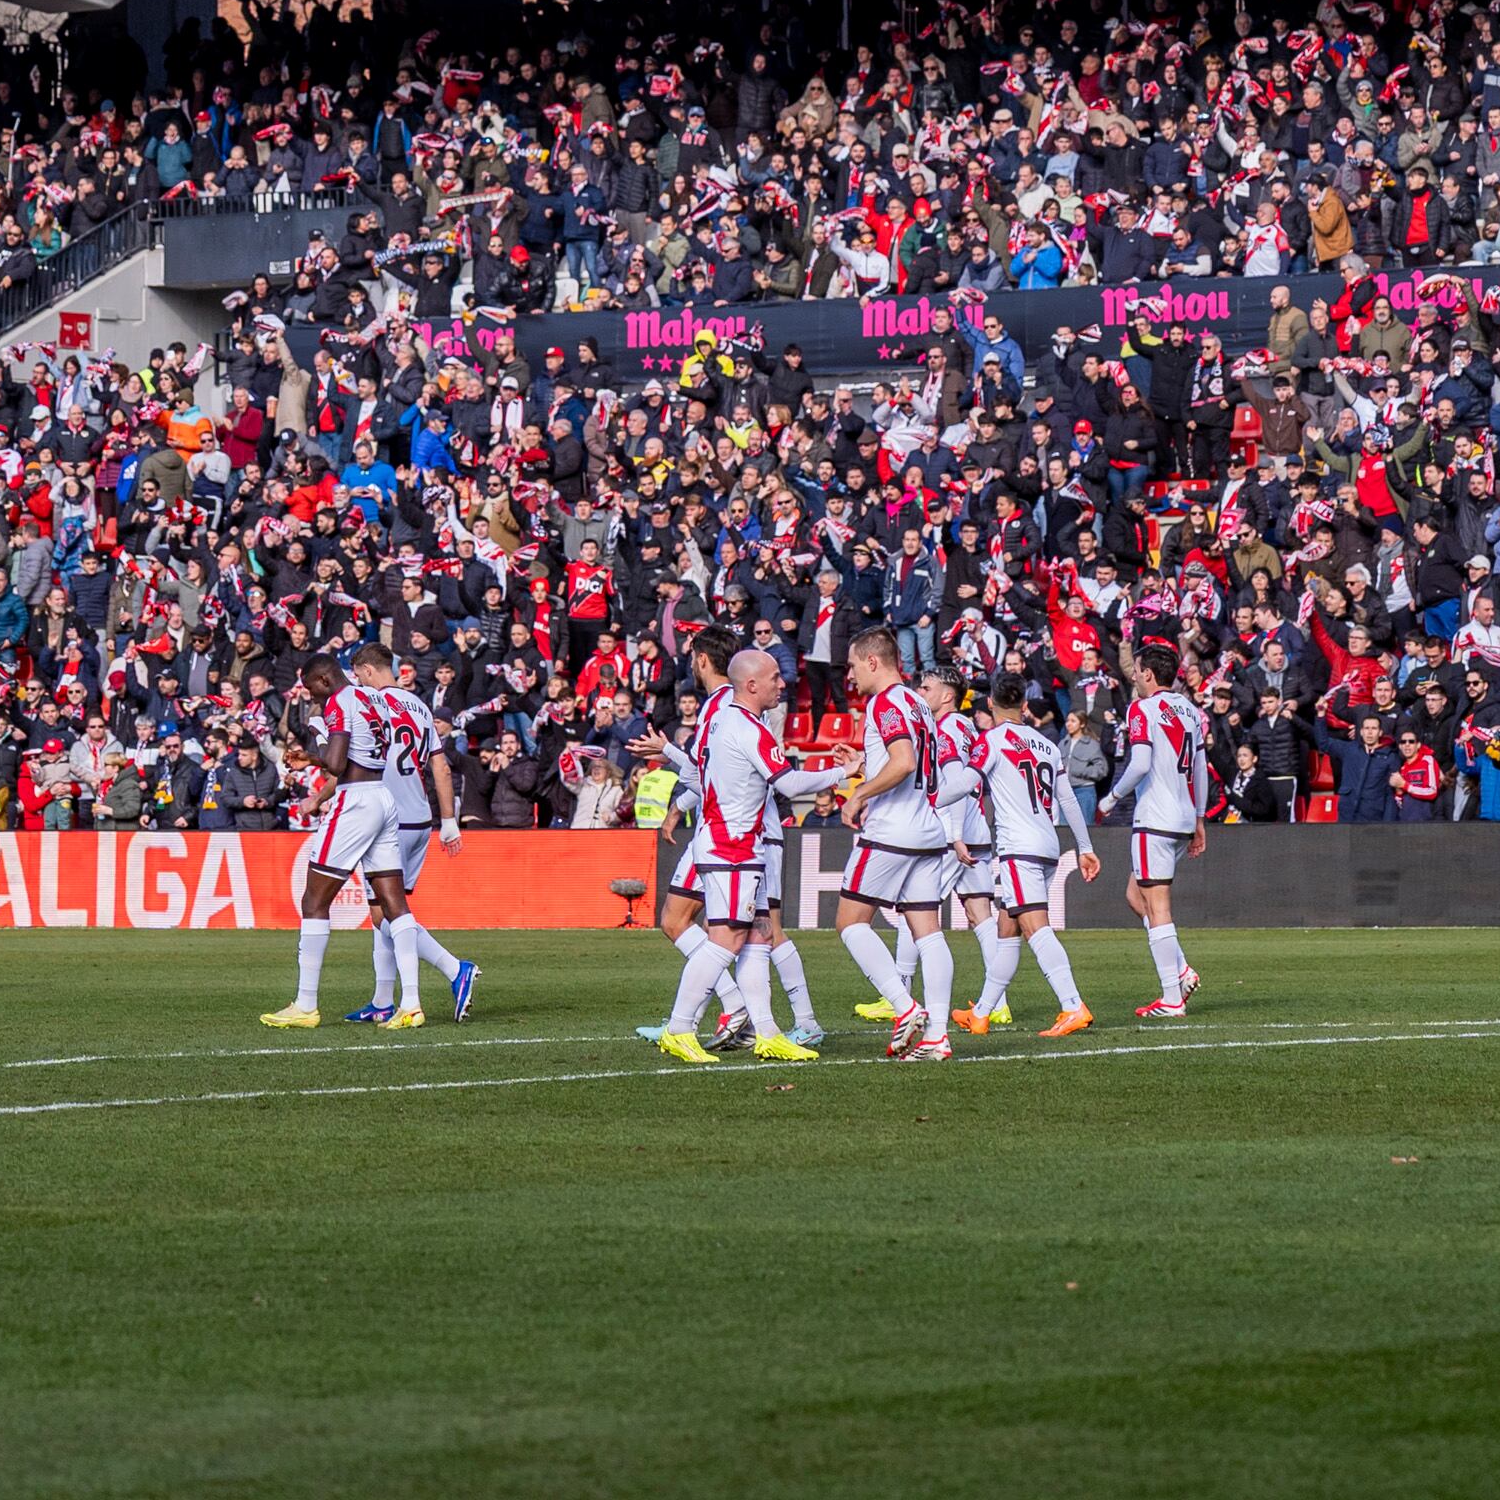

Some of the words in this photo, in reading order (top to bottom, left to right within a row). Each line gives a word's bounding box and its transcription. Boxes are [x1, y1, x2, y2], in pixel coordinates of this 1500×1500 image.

[625, 308, 748, 348] Mahou
[862, 296, 985, 337] Mahu
[576, 577, 604, 594] DIGI
[1072, 640, 1095, 652] DIG
[394, 725, 431, 777] 24
[915, 727, 938, 795] 19
[1177, 731, 1193, 776] 4
[1018, 760, 1054, 815] 18
